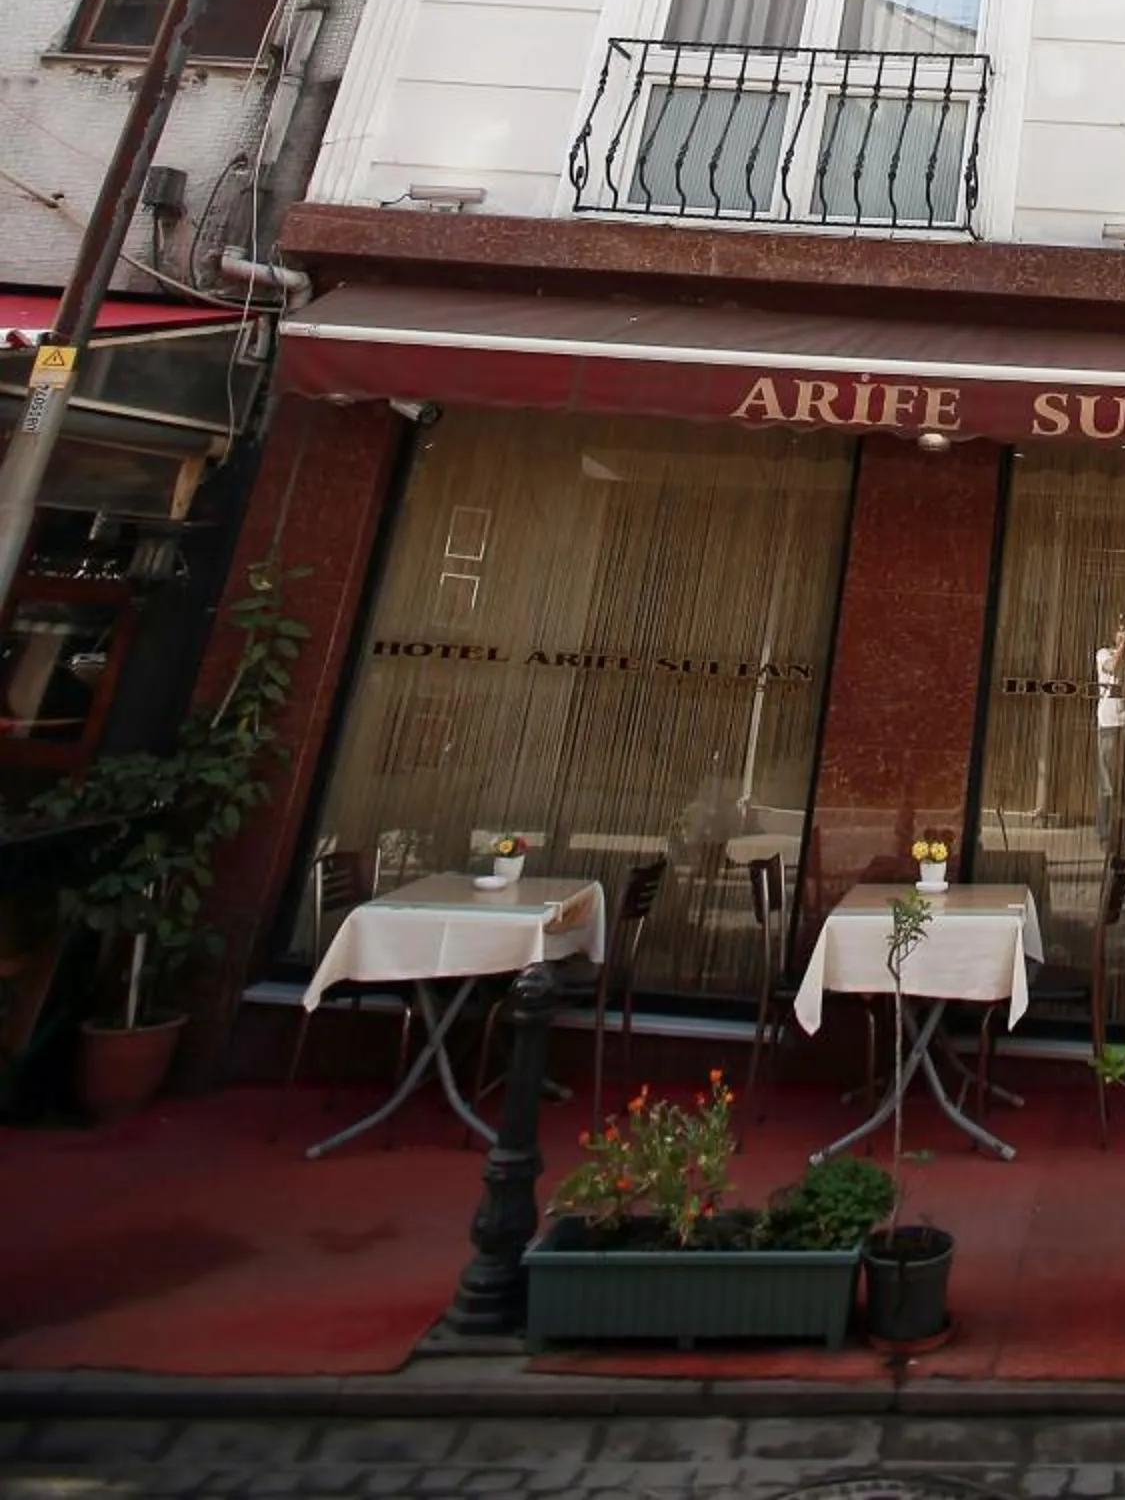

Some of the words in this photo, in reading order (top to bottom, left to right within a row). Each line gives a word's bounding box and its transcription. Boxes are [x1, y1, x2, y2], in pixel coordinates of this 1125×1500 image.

[730, 373, 961, 431] ARİFE
[372, 641, 511, 663] HOTEL
[655, 657, 814, 681] SULTAN
